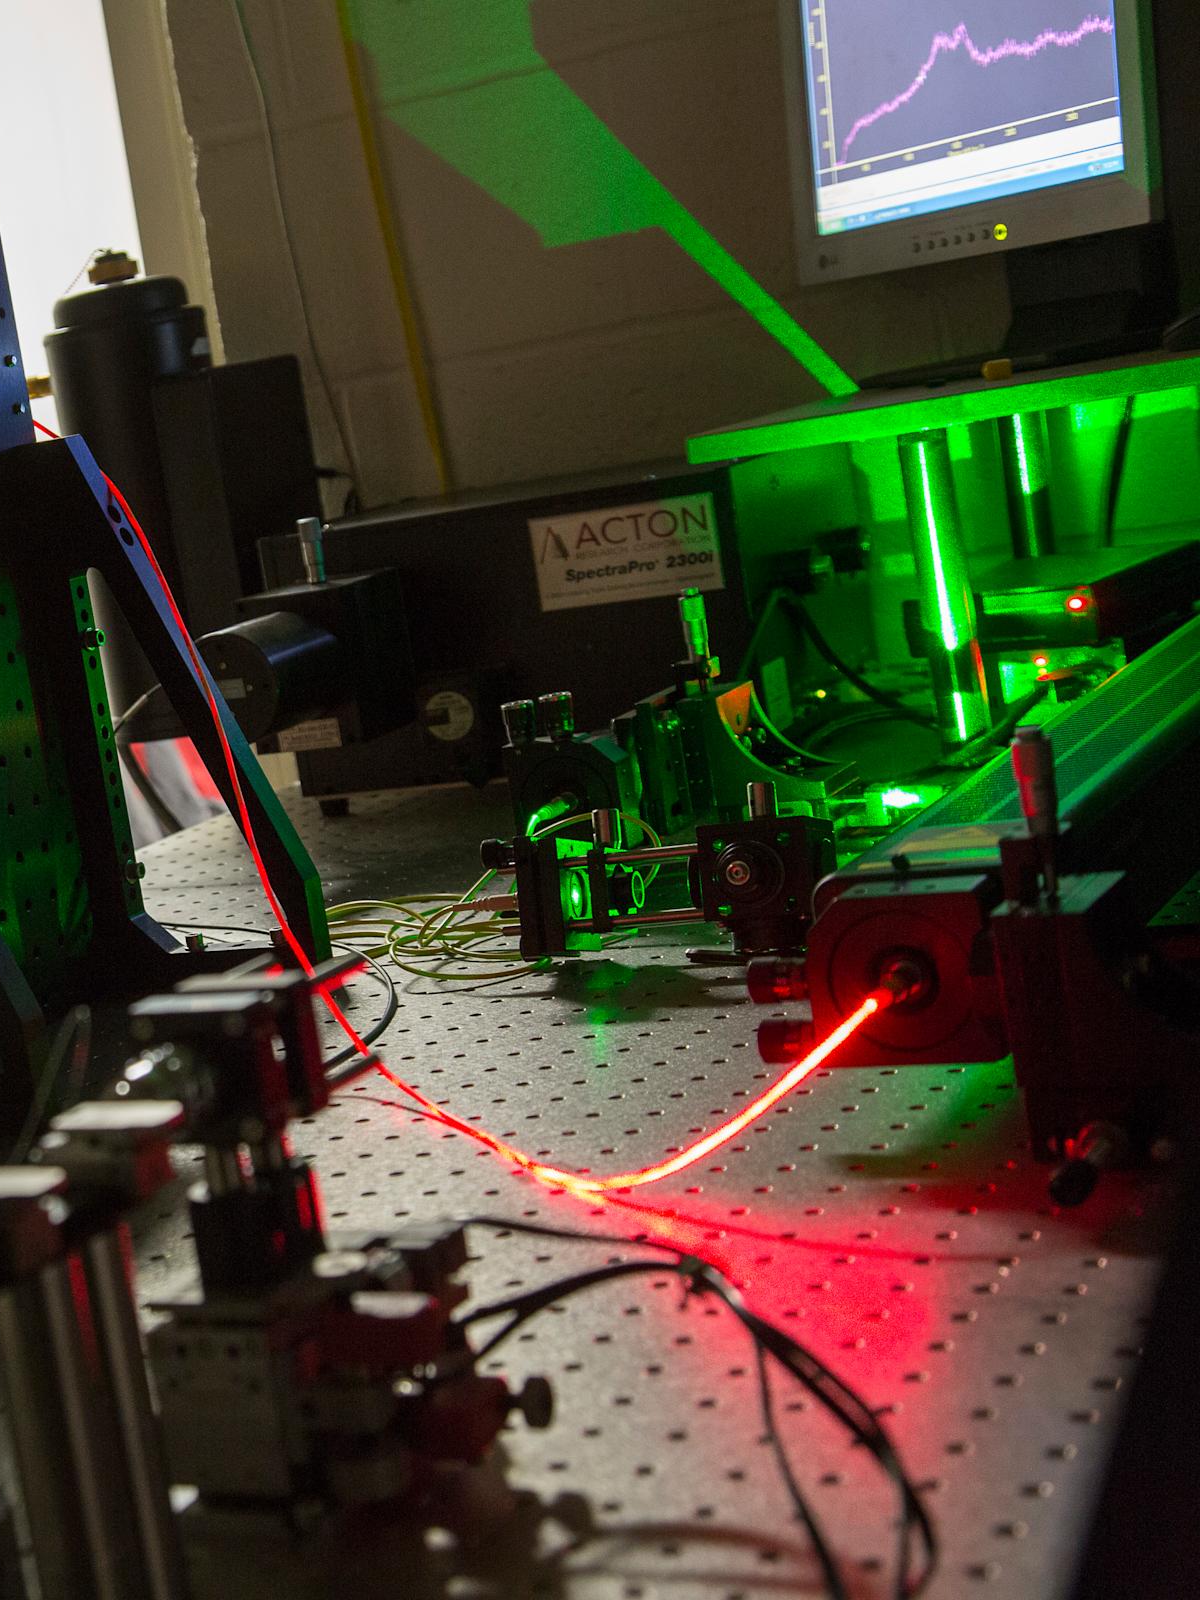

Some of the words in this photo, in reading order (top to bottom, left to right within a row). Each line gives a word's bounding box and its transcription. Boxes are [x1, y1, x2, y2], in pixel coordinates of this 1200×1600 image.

[576, 504, 708, 549] ACTON
[565, 560, 657, 583] SpectraPro
[666, 552, 713, 568] 2300i
